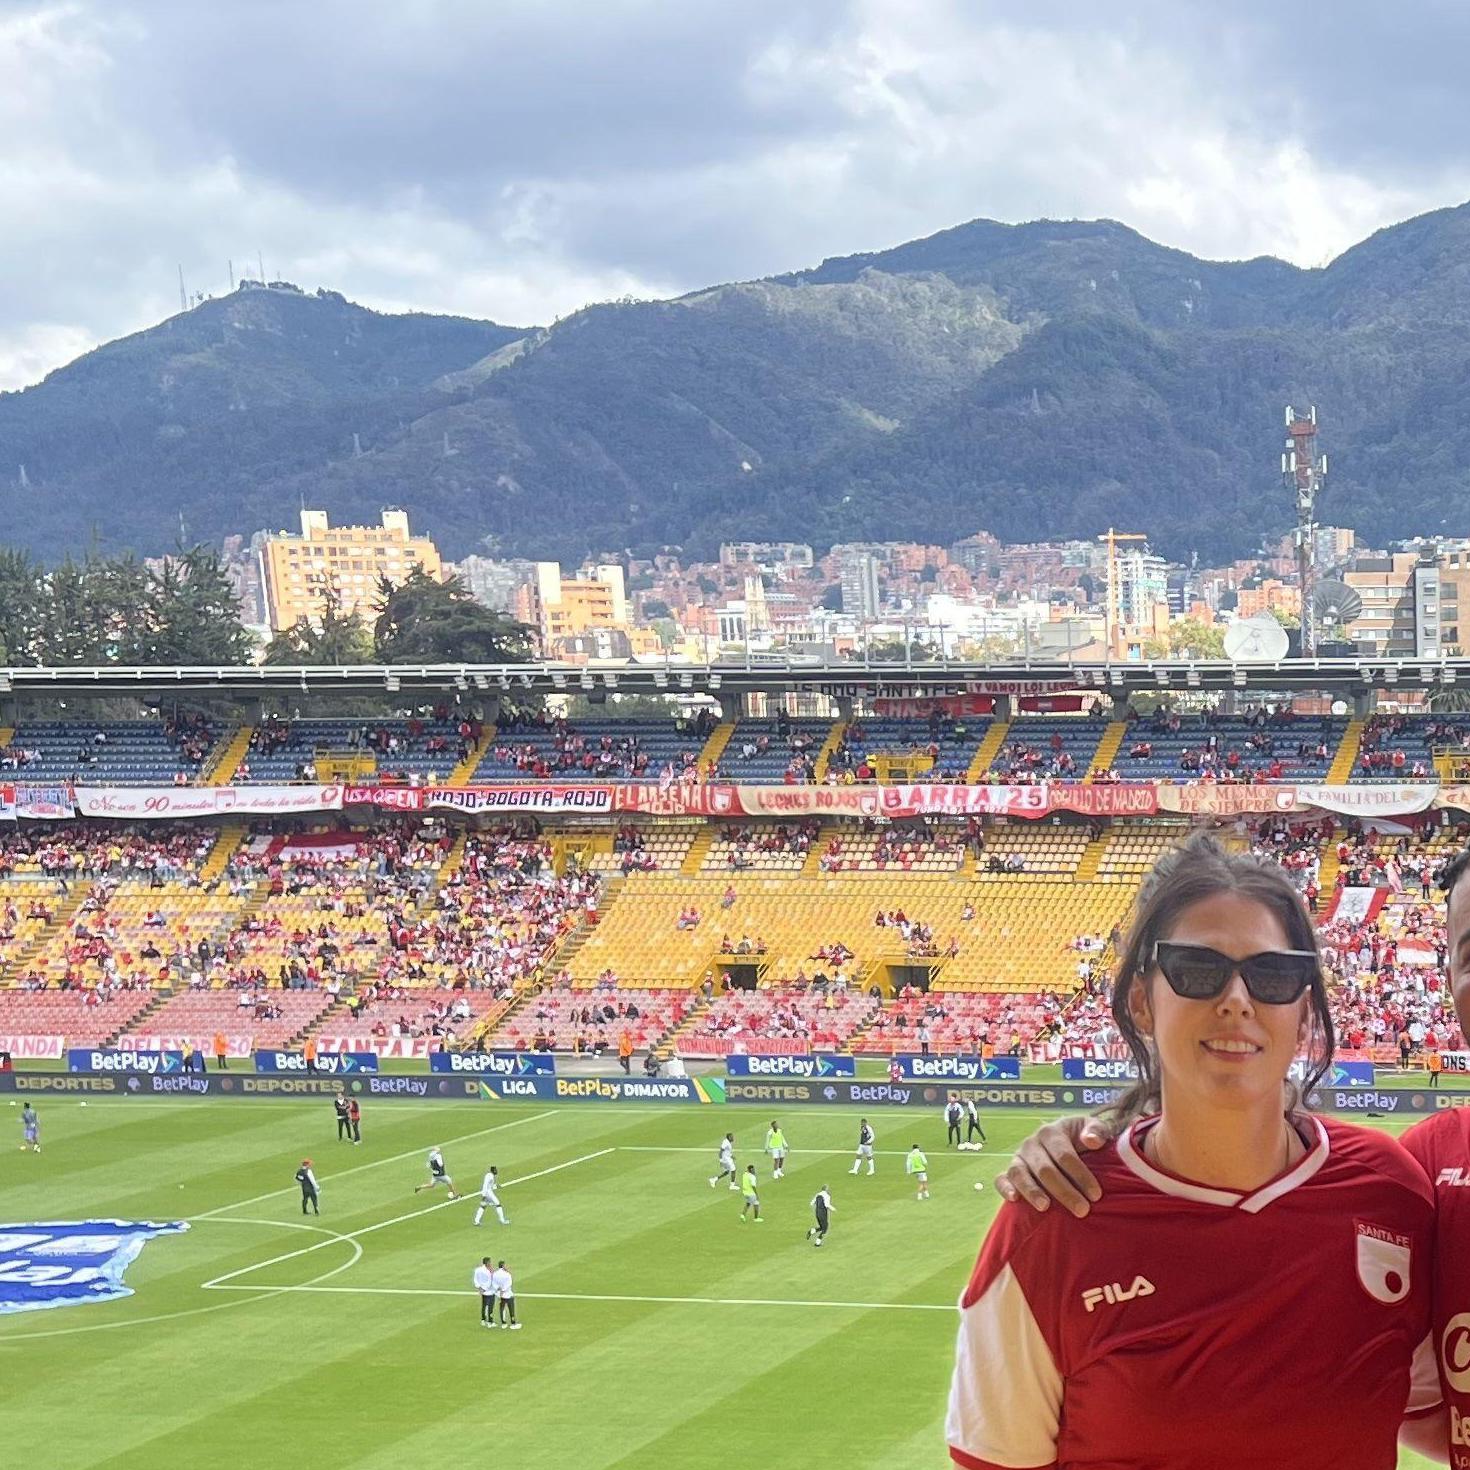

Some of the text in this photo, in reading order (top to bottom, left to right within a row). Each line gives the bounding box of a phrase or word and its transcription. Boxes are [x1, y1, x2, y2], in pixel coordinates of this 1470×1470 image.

[144, 796, 170, 813] 90
[562, 790, 608, 807] ROJO
[884, 786, 1043, 808] BARRA 25
[1208, 800, 1272, 814] SIEMPRE
[91, 1052, 160, 1075] BetPlay
[275, 1053, 340, 1074] Betlay
[451, 1053, 516, 1075] BetPlay
[748, 1057, 814, 1078] BetPlay
[912, 1058, 979, 1080] BetPlay
[15, 1075, 428, 1096] DEPORTES BetPlay DEPORTES BetPlay
[502, 1079, 690, 1100] LIGA BetPlay DIMAYOR
[850, 1084, 912, 1104] BetPlay
[1336, 1093, 1399, 1111] BetPlay
[1358, 1222, 1410, 1249] SANTA FE
[1081, 1274, 1156, 1313] FILA
